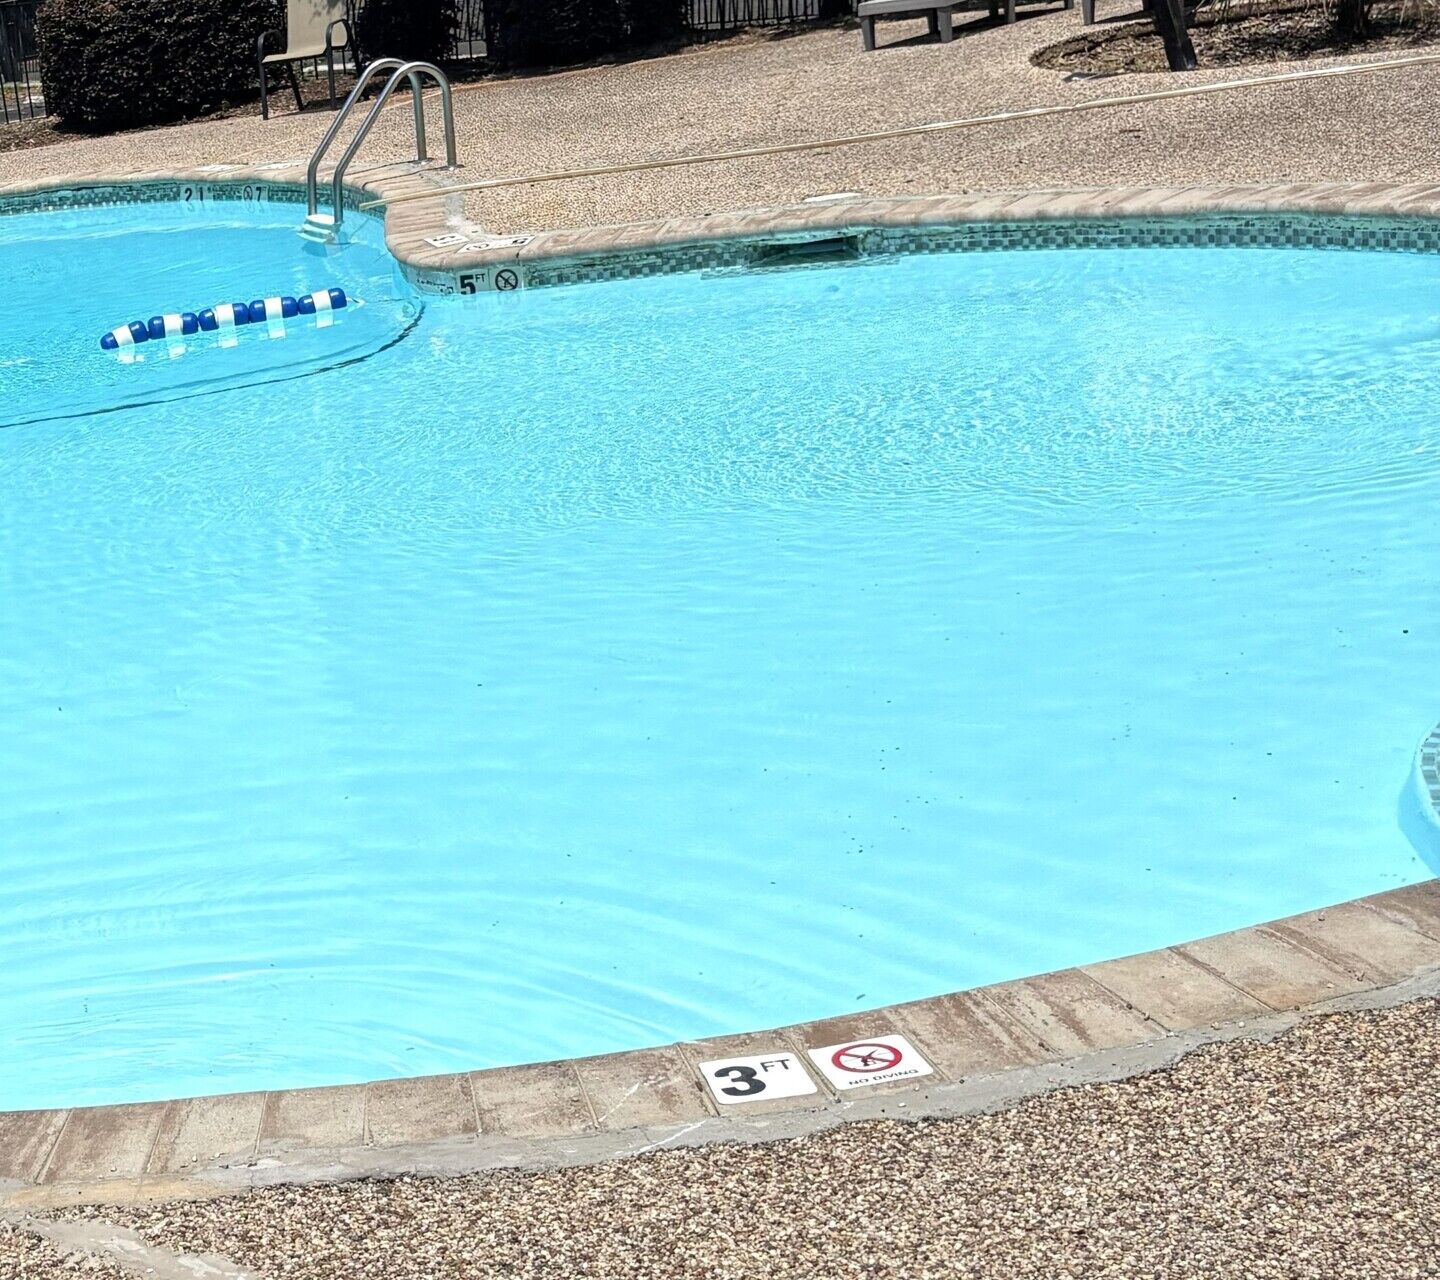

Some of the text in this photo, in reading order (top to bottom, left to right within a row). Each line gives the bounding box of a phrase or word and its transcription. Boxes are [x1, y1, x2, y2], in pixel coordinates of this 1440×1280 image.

[459, 274, 476, 295] 5
[475, 273, 486, 283] FT
[713, 1058, 792, 1097] 3 FT
[848, 1069, 919, 1086] NO DIVING
